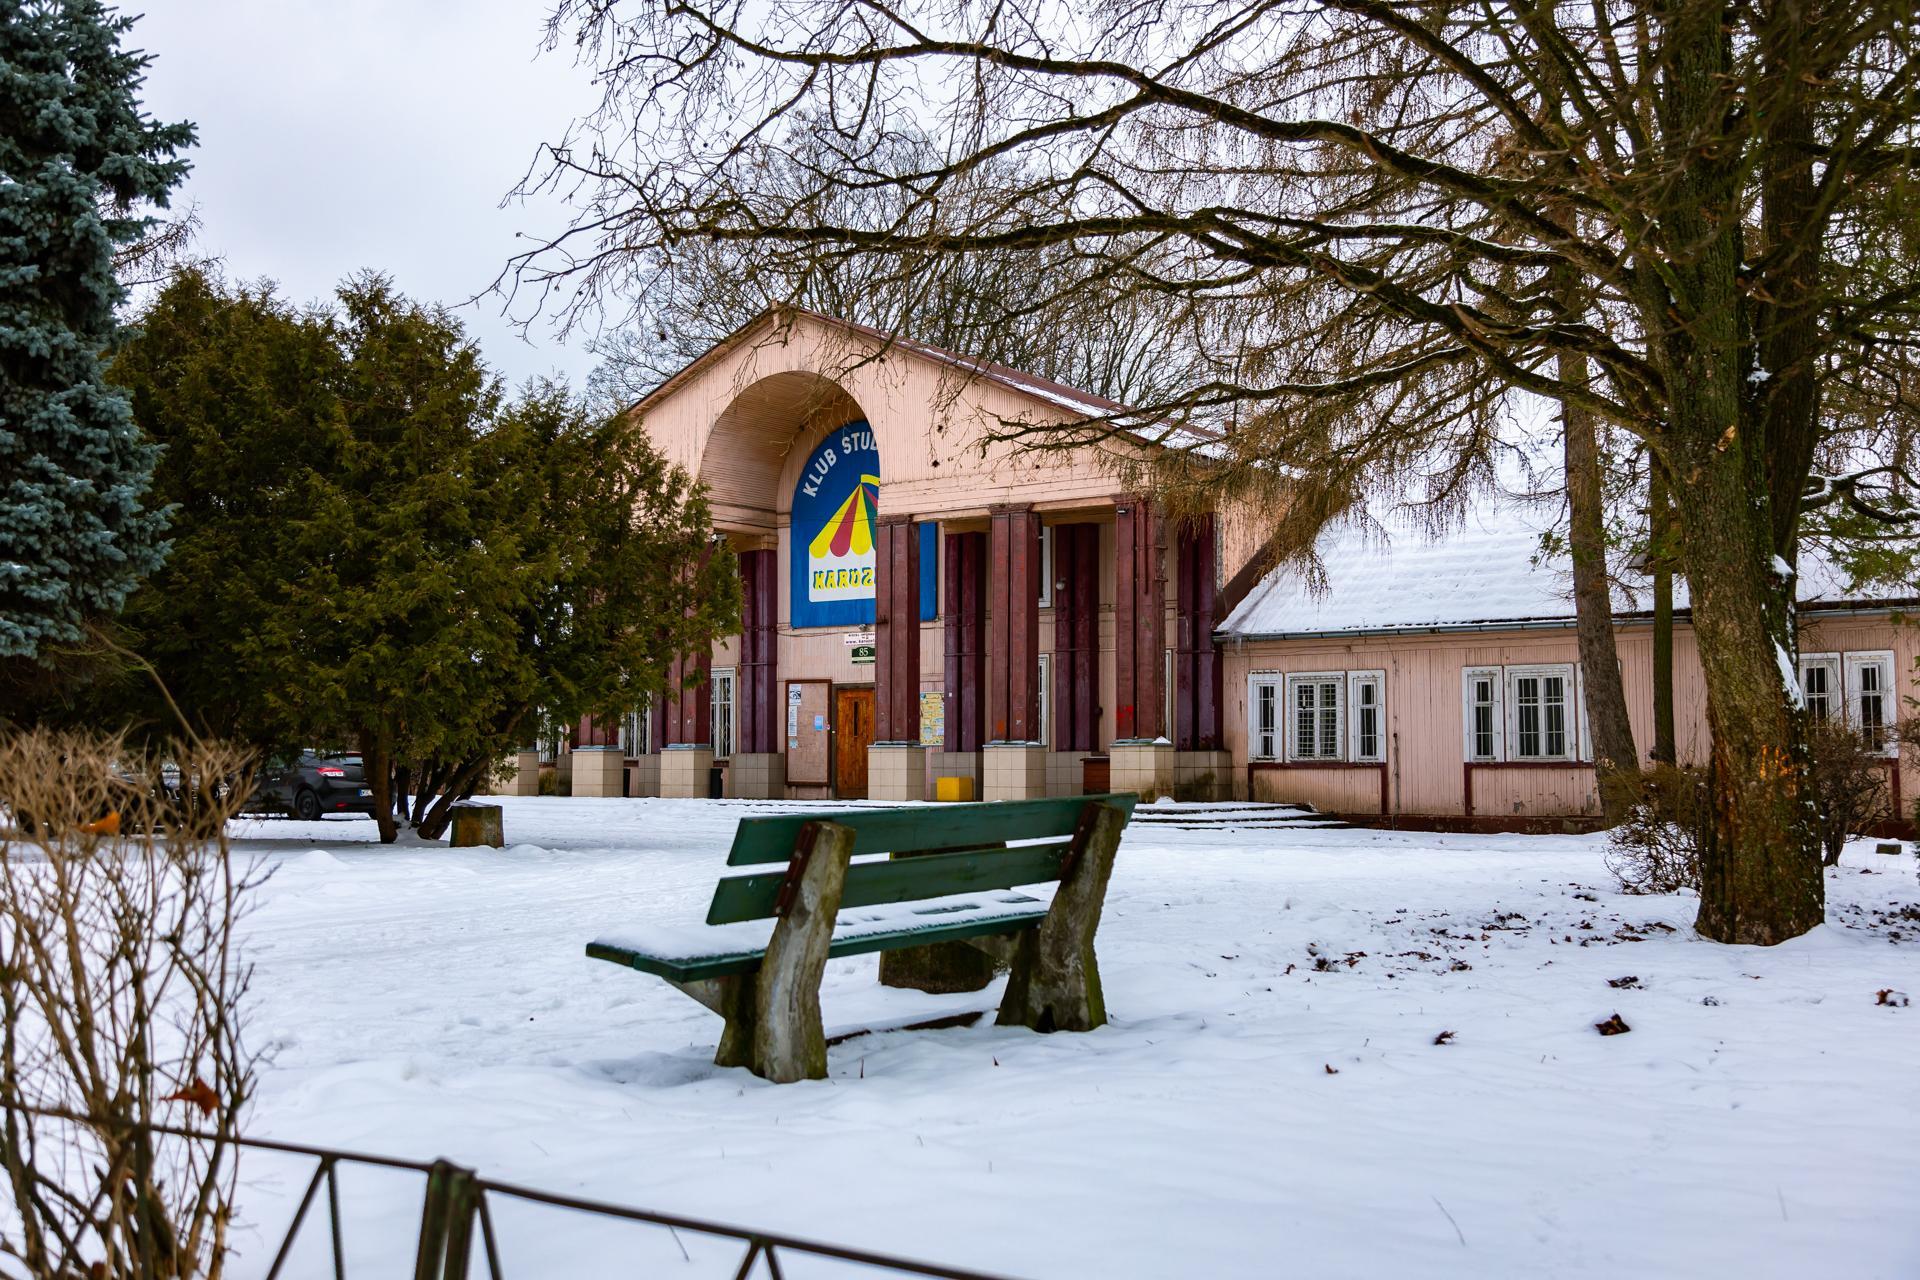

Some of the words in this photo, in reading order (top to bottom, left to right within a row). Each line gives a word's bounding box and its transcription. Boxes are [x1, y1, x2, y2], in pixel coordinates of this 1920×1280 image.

[803, 448, 837, 498] KLUB
[813, 567, 876, 590] KARUZ
[859, 647, 869, 657] 85
